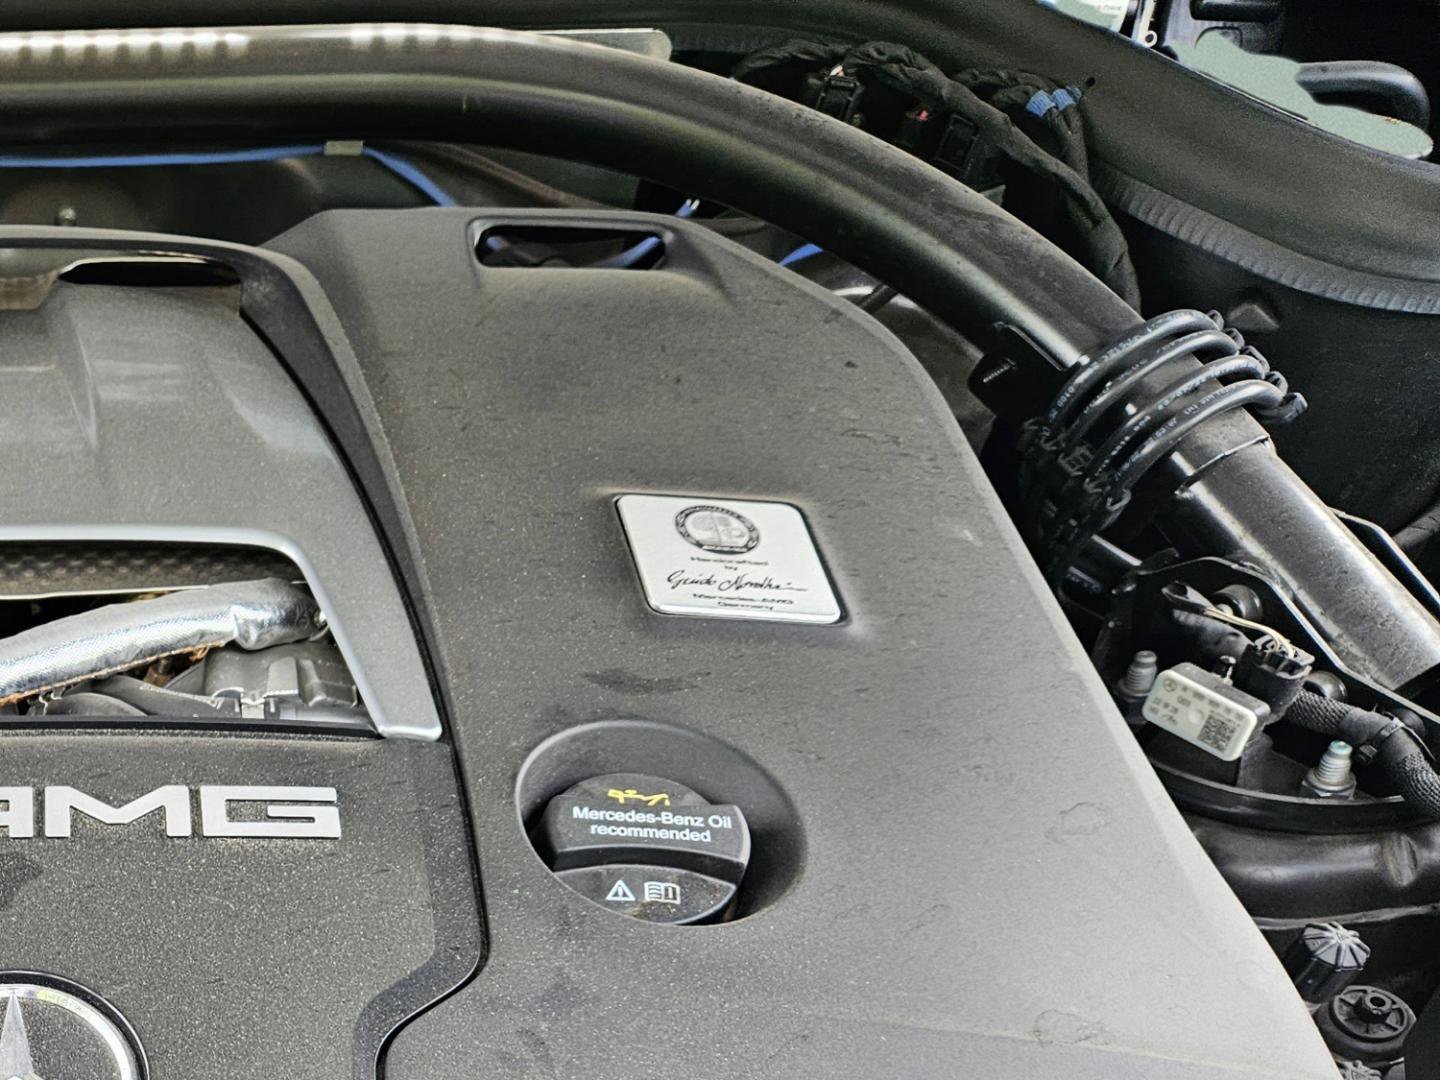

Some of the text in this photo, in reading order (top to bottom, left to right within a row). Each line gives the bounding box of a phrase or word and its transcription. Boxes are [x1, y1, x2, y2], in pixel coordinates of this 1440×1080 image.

[572, 805, 732, 829] Mercedes-Benz Oil
[590, 823, 712, 843] recommended
